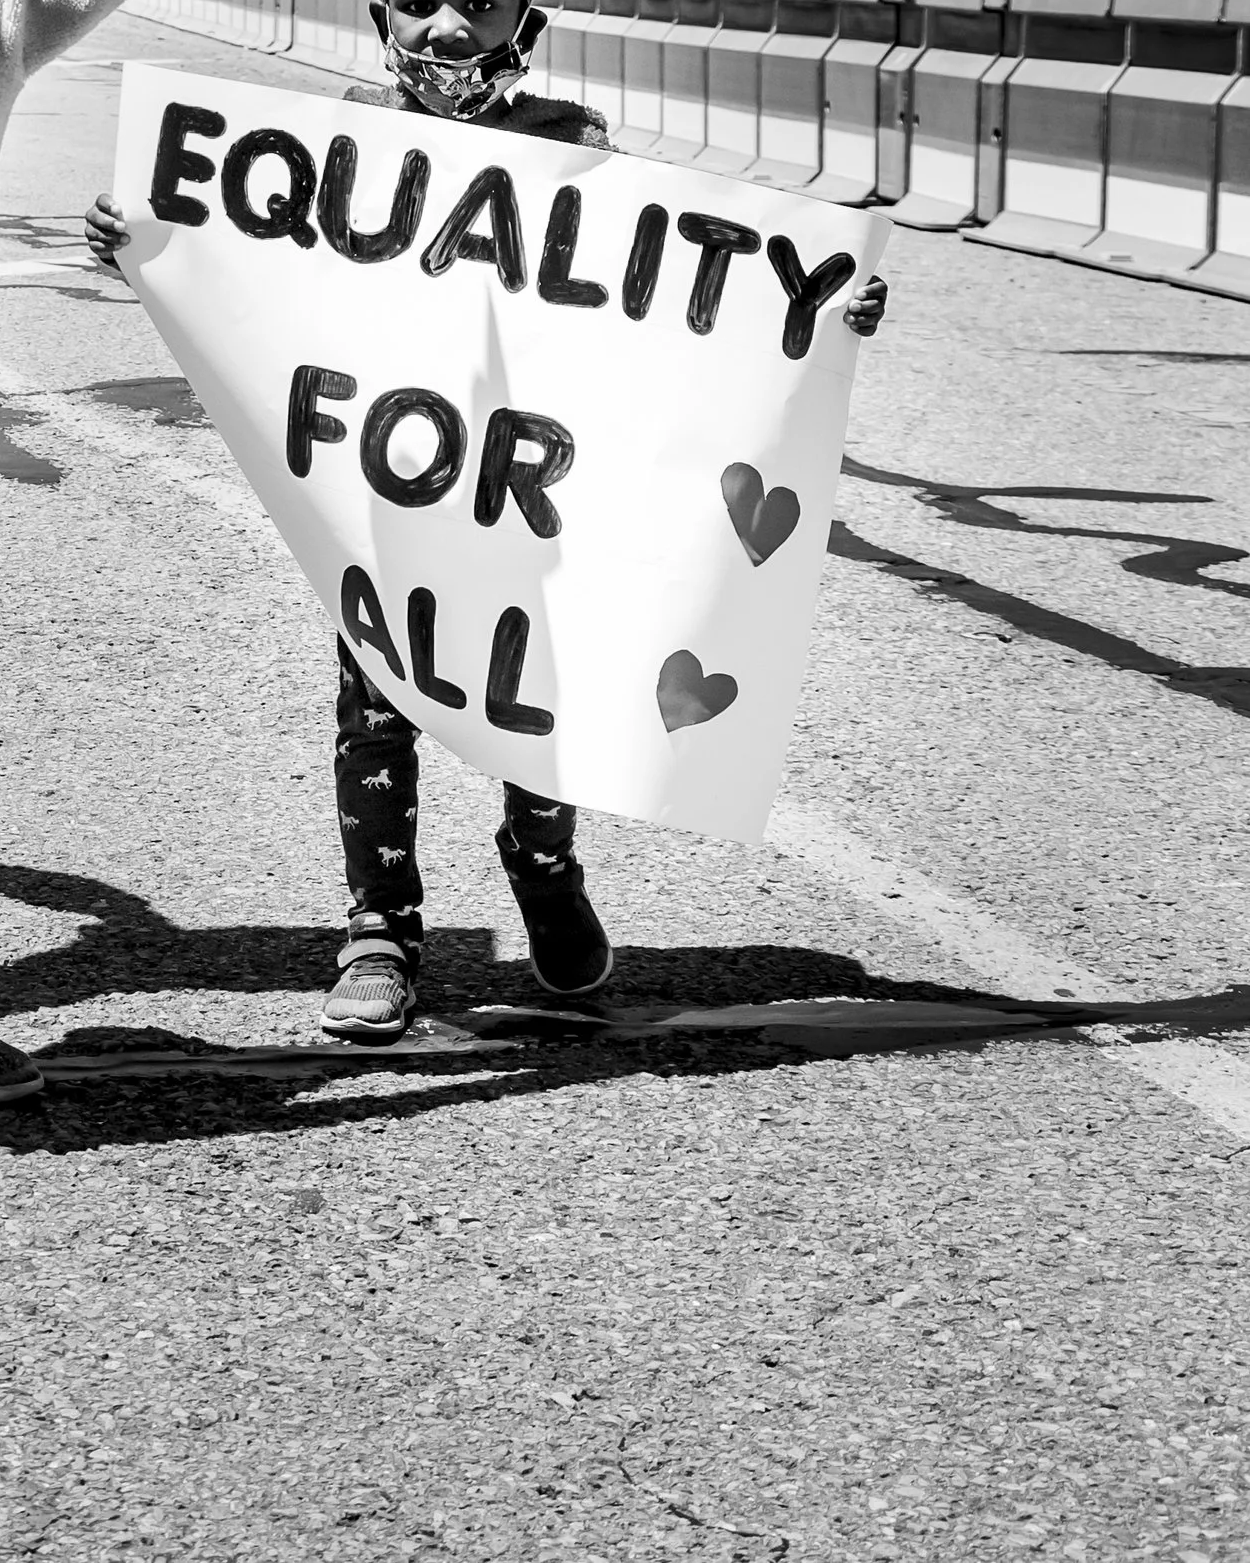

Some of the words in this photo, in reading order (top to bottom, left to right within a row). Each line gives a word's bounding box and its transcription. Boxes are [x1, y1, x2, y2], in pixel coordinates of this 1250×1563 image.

[149, 101, 857, 361] EQUALITY
[286, 364, 576, 540] FOR
[339, 564, 555, 737] ALL
